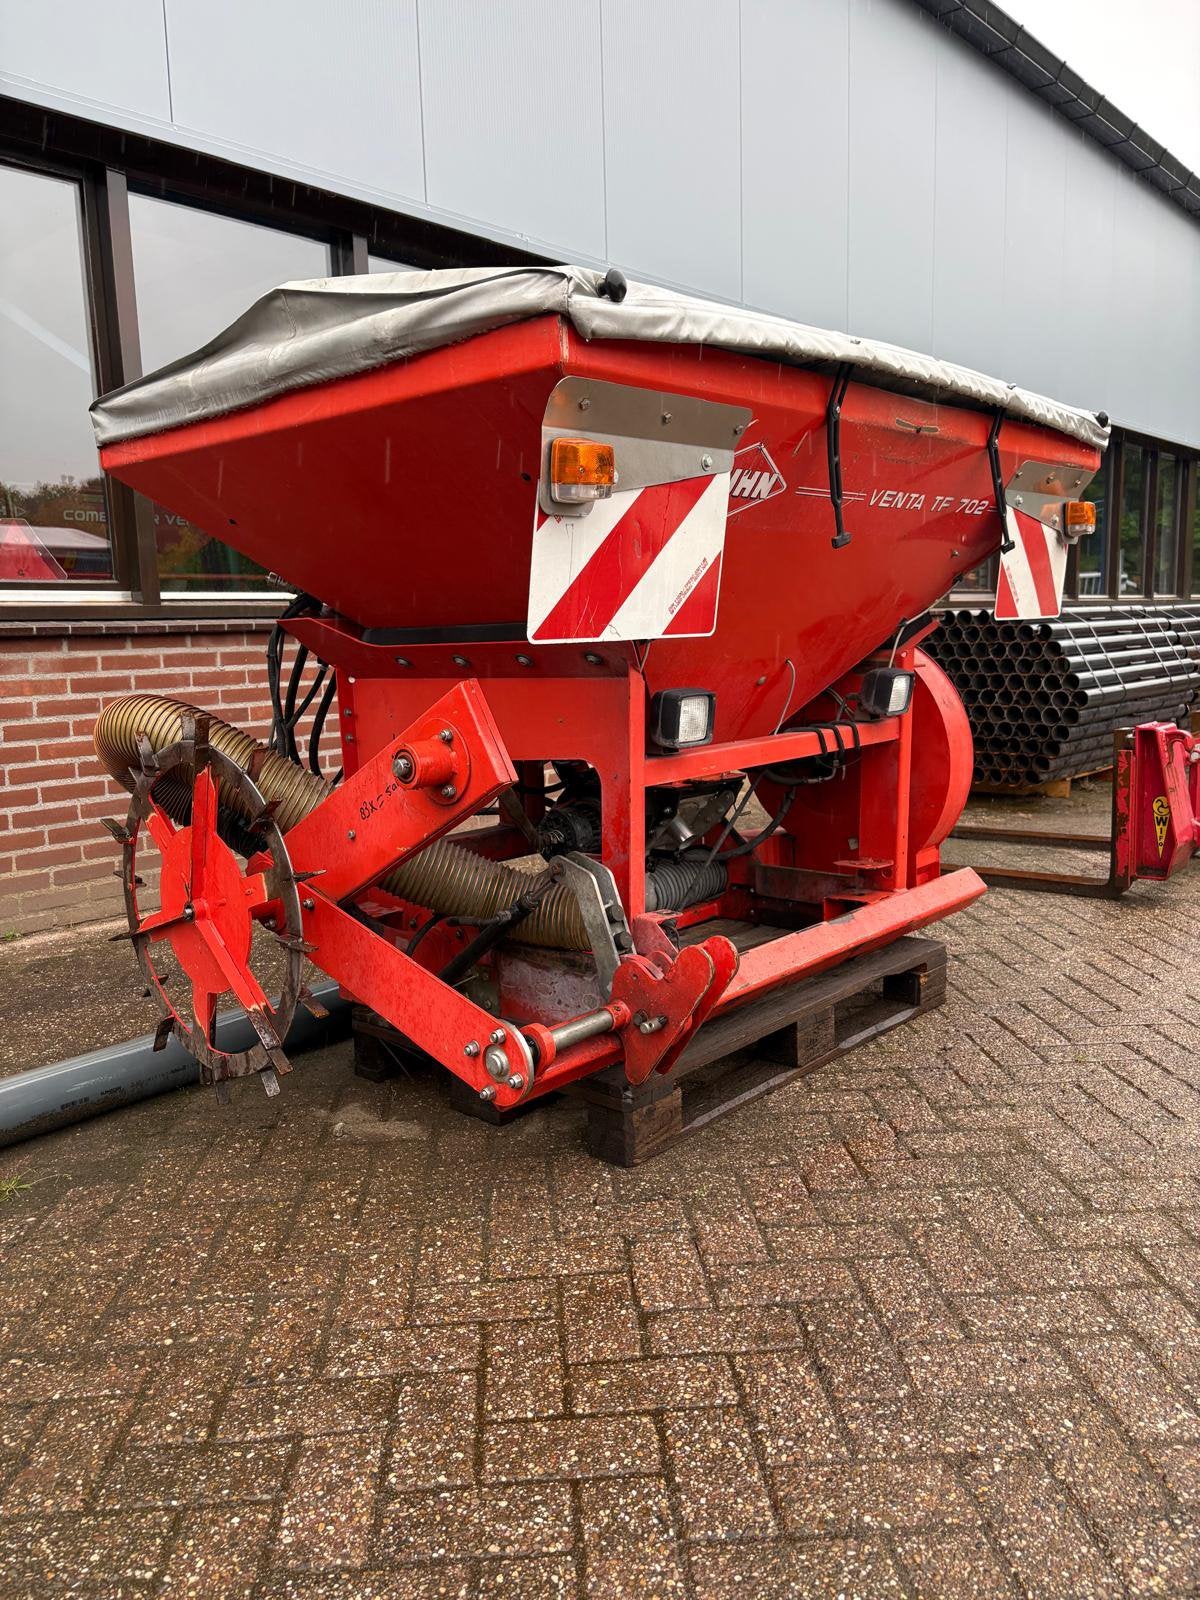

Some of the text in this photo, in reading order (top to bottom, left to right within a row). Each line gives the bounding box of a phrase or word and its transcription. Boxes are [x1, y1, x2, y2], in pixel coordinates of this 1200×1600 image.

[869, 489, 989, 515] VENTA TF 702
[1155, 816, 1168, 847] WIFO
